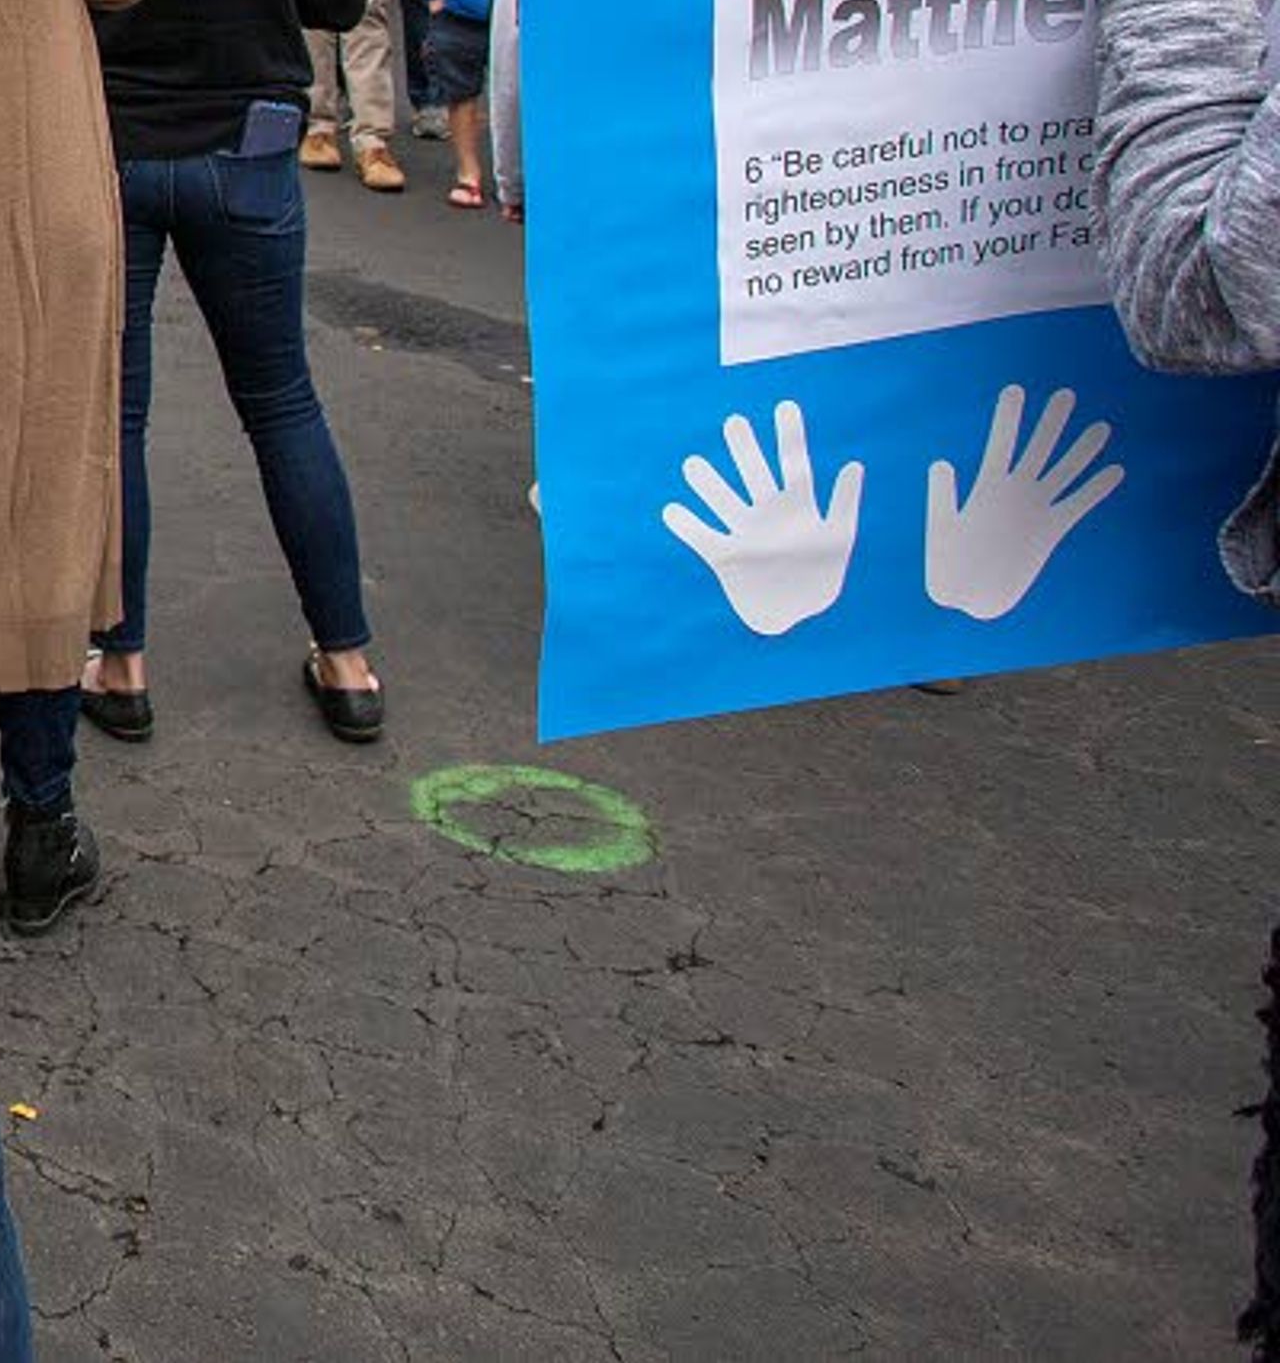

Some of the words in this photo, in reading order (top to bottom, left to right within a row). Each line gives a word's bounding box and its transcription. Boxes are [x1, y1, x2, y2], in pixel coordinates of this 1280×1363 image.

[745, 156, 764, 184] 6
[832, 129, 933, 170] careful
[943, 122, 988, 152] not
[998, 121, 1029, 145] to
[745, 170, 949, 226] righteousness
[960, 160, 984, 188] in
[995, 151, 1066, 182] front
[746, 229, 815, 260] seen
[825, 220, 860, 251] by
[869, 208, 949, 239] them.
[961, 195, 981, 223] If
[989, 195, 1043, 227] you
[746, 272, 783, 298] no
[792, 249, 892, 290] reward
[901, 242, 965, 272] from
[973, 230, 1040, 267] your
